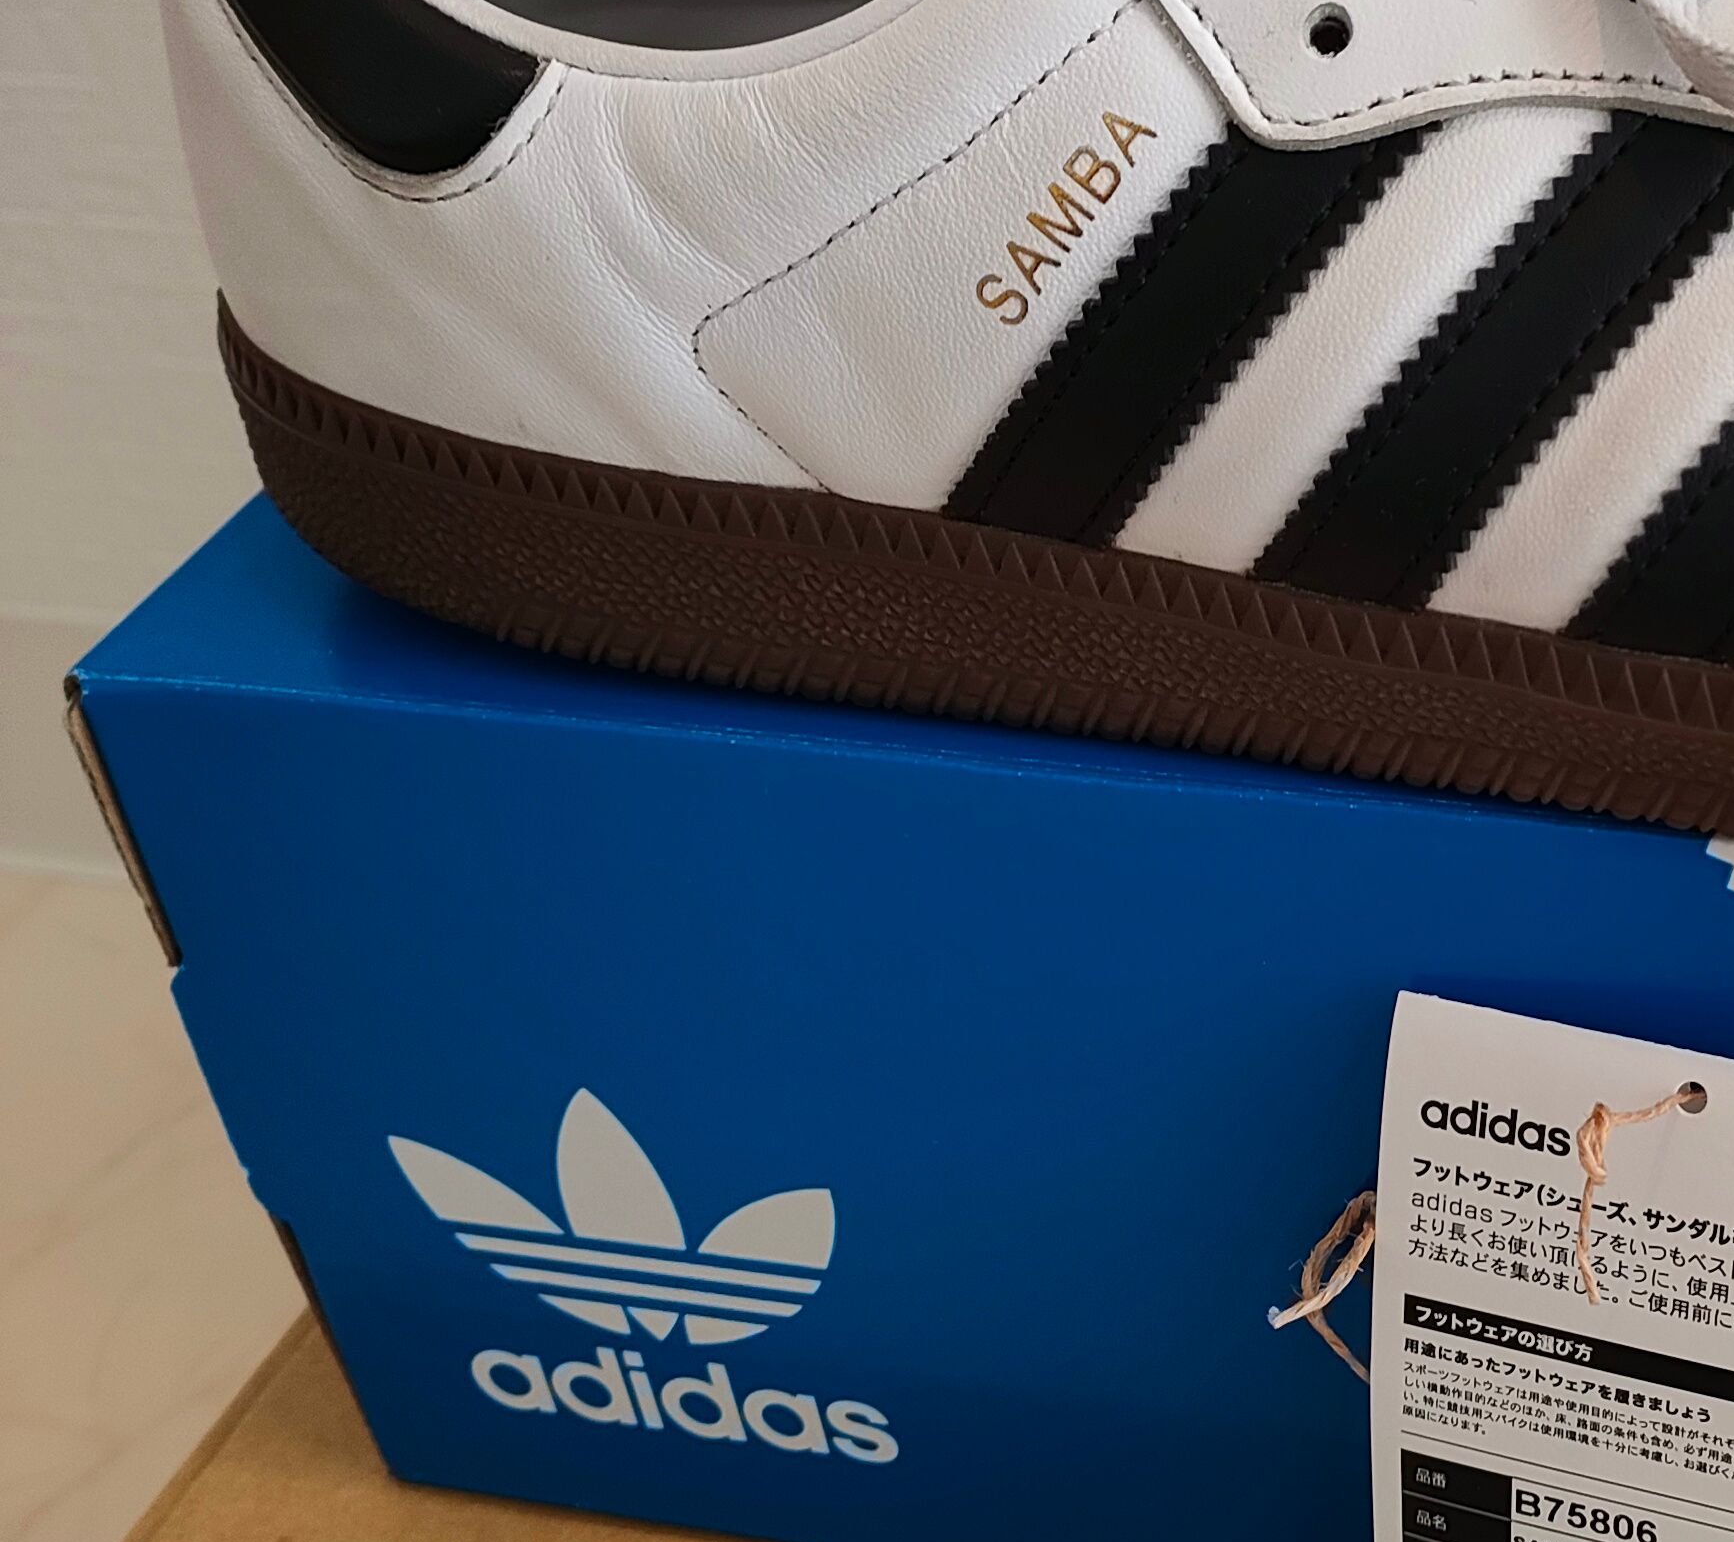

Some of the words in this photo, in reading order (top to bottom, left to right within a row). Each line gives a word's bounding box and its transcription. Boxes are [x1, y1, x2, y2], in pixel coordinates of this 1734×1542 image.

[974, 109, 1158, 327] SAMBA
[1420, 1098, 1572, 1158] adidas
[1411, 1191, 1493, 1223] adidas
[1415, 1305, 1594, 1363] フットウェアの選び方
[470, 1345, 899, 1464] adidas
[1404, 1338, 1711, 1423] 用途にあったフットウェアを履きましょう
[1416, 1468, 1447, 1489] 品番
[1416, 1509, 1447, 1531] 品名
